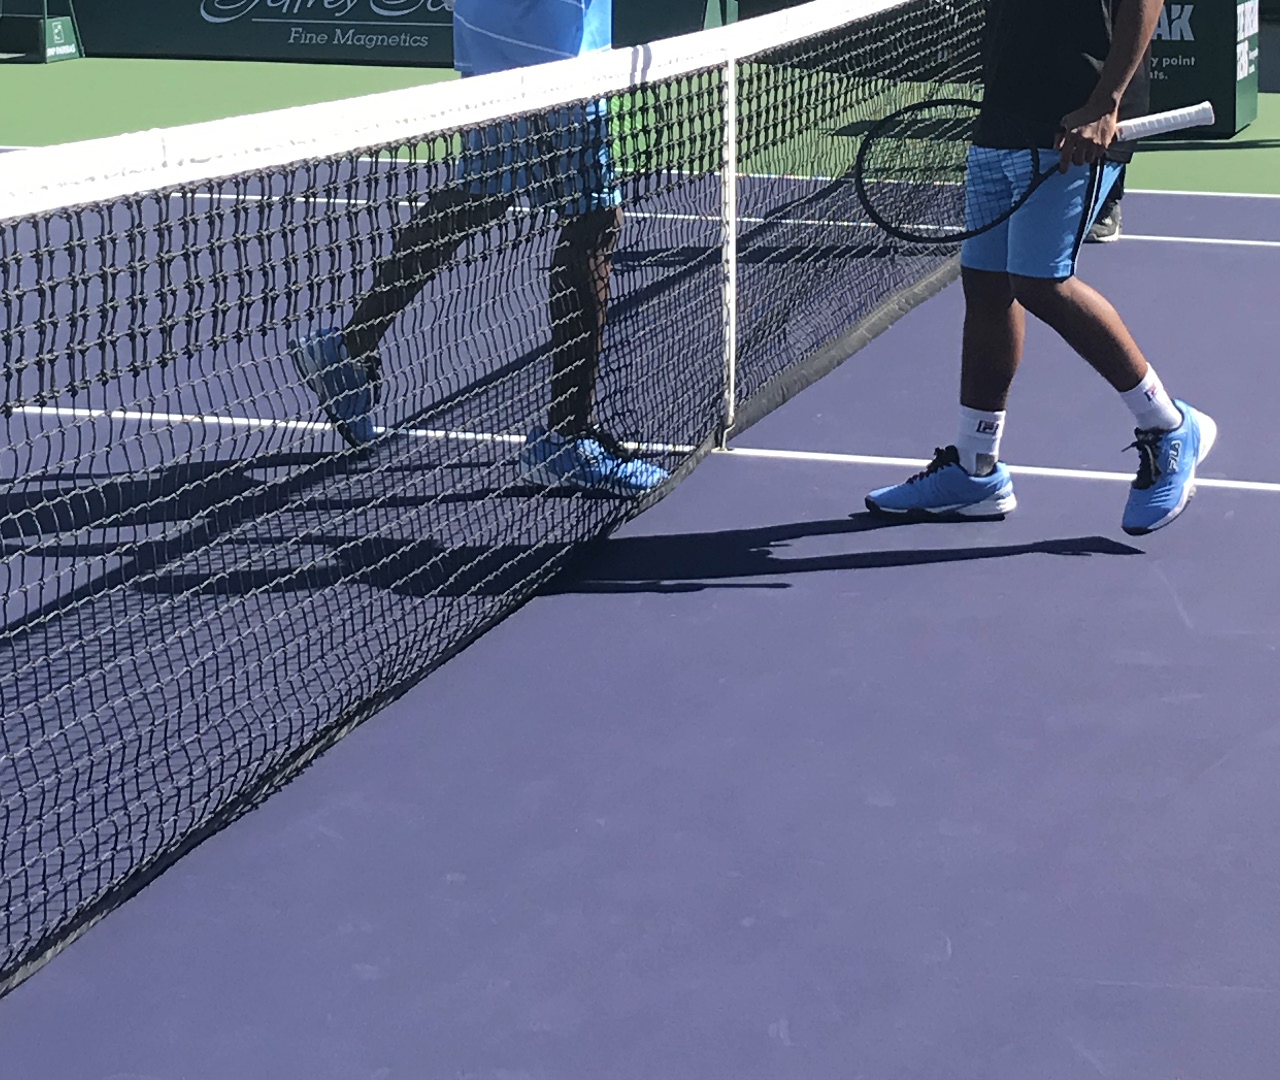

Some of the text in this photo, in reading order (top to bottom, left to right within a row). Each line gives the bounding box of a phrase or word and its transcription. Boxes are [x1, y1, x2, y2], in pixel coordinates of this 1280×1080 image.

[1151, 4, 1195, 41] AK
[288, 27, 429, 49] Fine Magnetics
[1162, 54, 1195, 68] point
